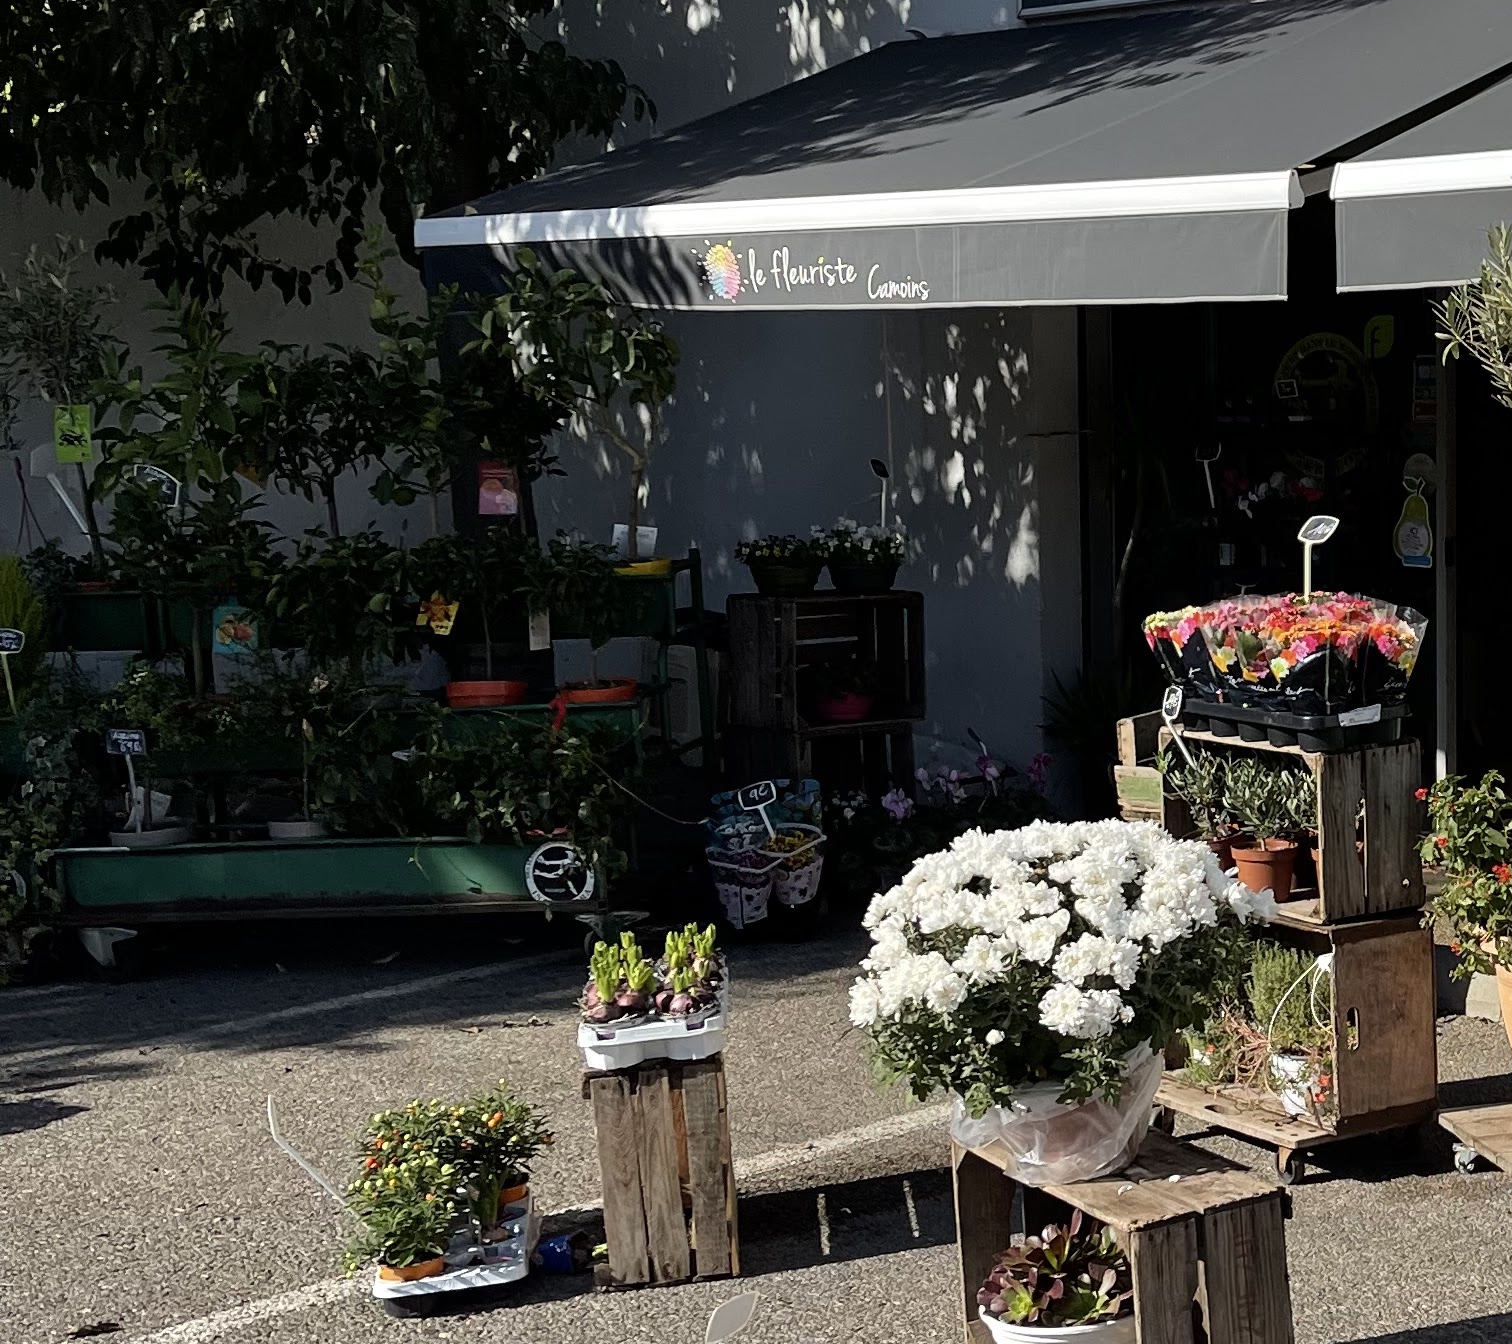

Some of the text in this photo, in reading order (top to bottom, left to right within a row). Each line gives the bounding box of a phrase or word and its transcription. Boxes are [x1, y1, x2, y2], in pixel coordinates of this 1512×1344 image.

[748, 246, 930, 301] le fleuriste Camoins
